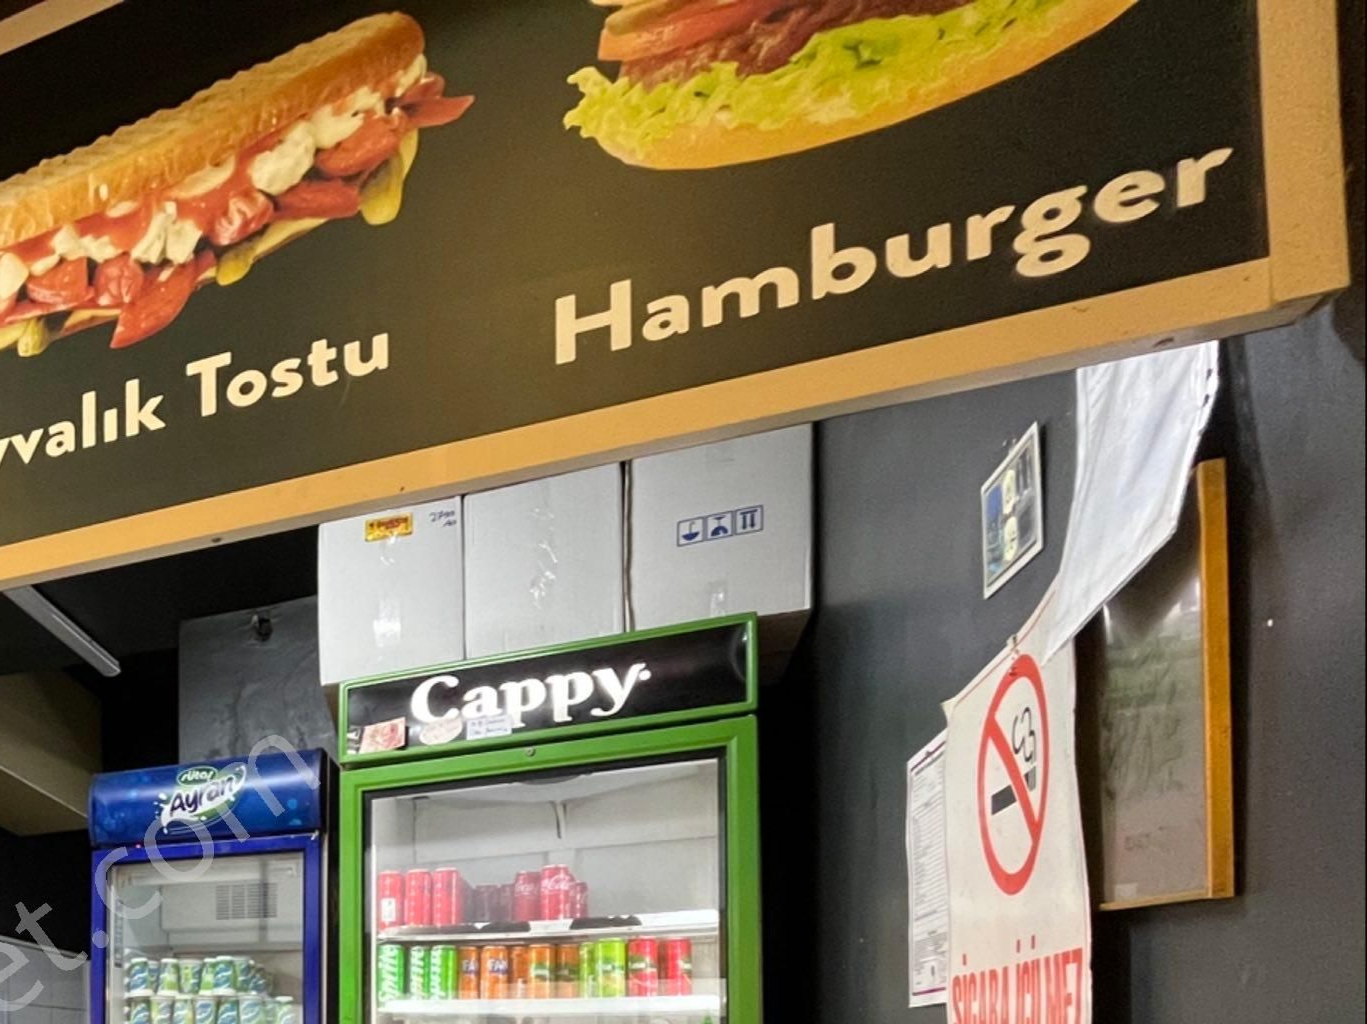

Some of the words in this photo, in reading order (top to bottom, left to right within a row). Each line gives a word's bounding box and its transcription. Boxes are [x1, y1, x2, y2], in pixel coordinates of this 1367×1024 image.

[555, 146, 1233, 366] Hamburger
[186, 332, 390, 417] Tostu
[409, 661, 652, 731] Cappy
[170, 775, 236, 816] Ayran
